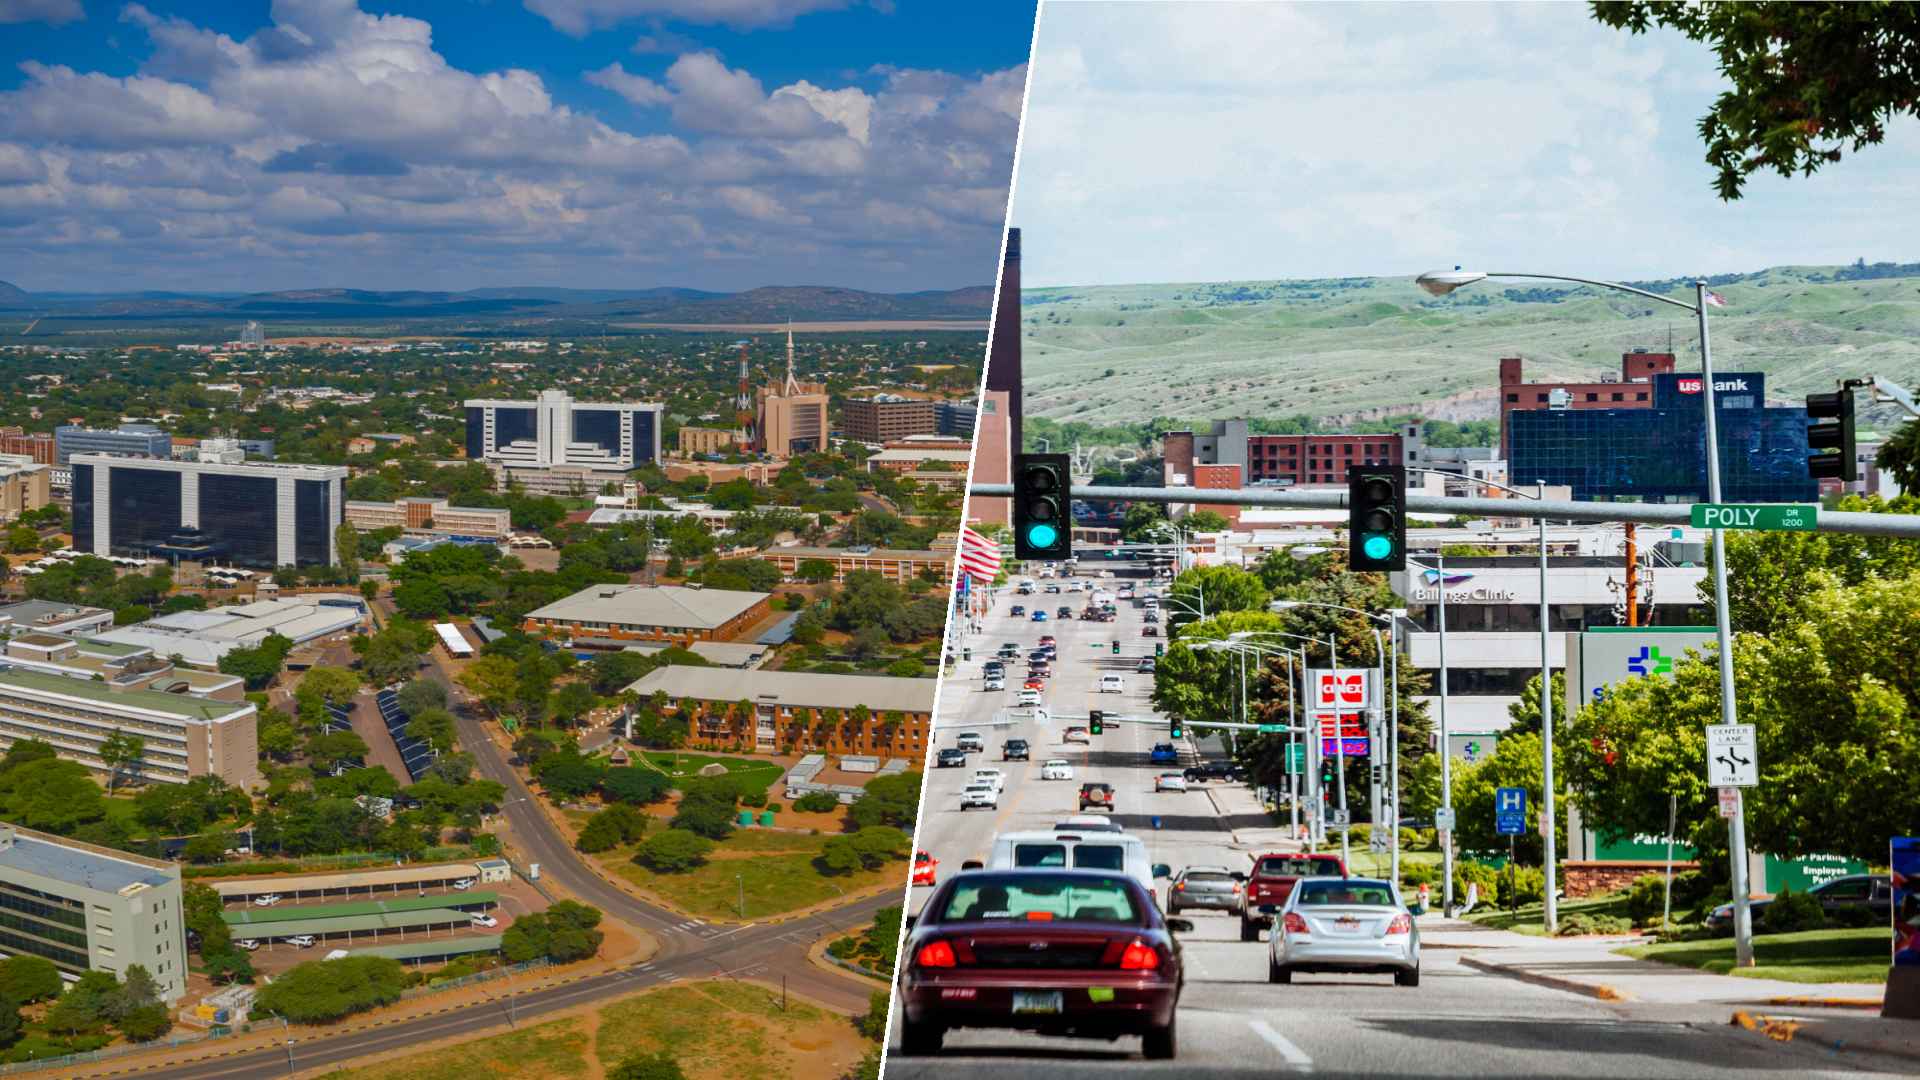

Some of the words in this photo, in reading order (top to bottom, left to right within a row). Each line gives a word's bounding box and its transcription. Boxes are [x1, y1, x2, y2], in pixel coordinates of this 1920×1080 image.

[1705, 508, 1760, 526] POLY
[1786, 509, 1798, 517] DR
[1782, 519, 1803, 527] 1200
[1416, 588, 1469, 602] Billngs
[1472, 588, 1514, 600] Clinic
[1503, 792, 1520, 810] H
[1803, 866, 1847, 877] Employee
